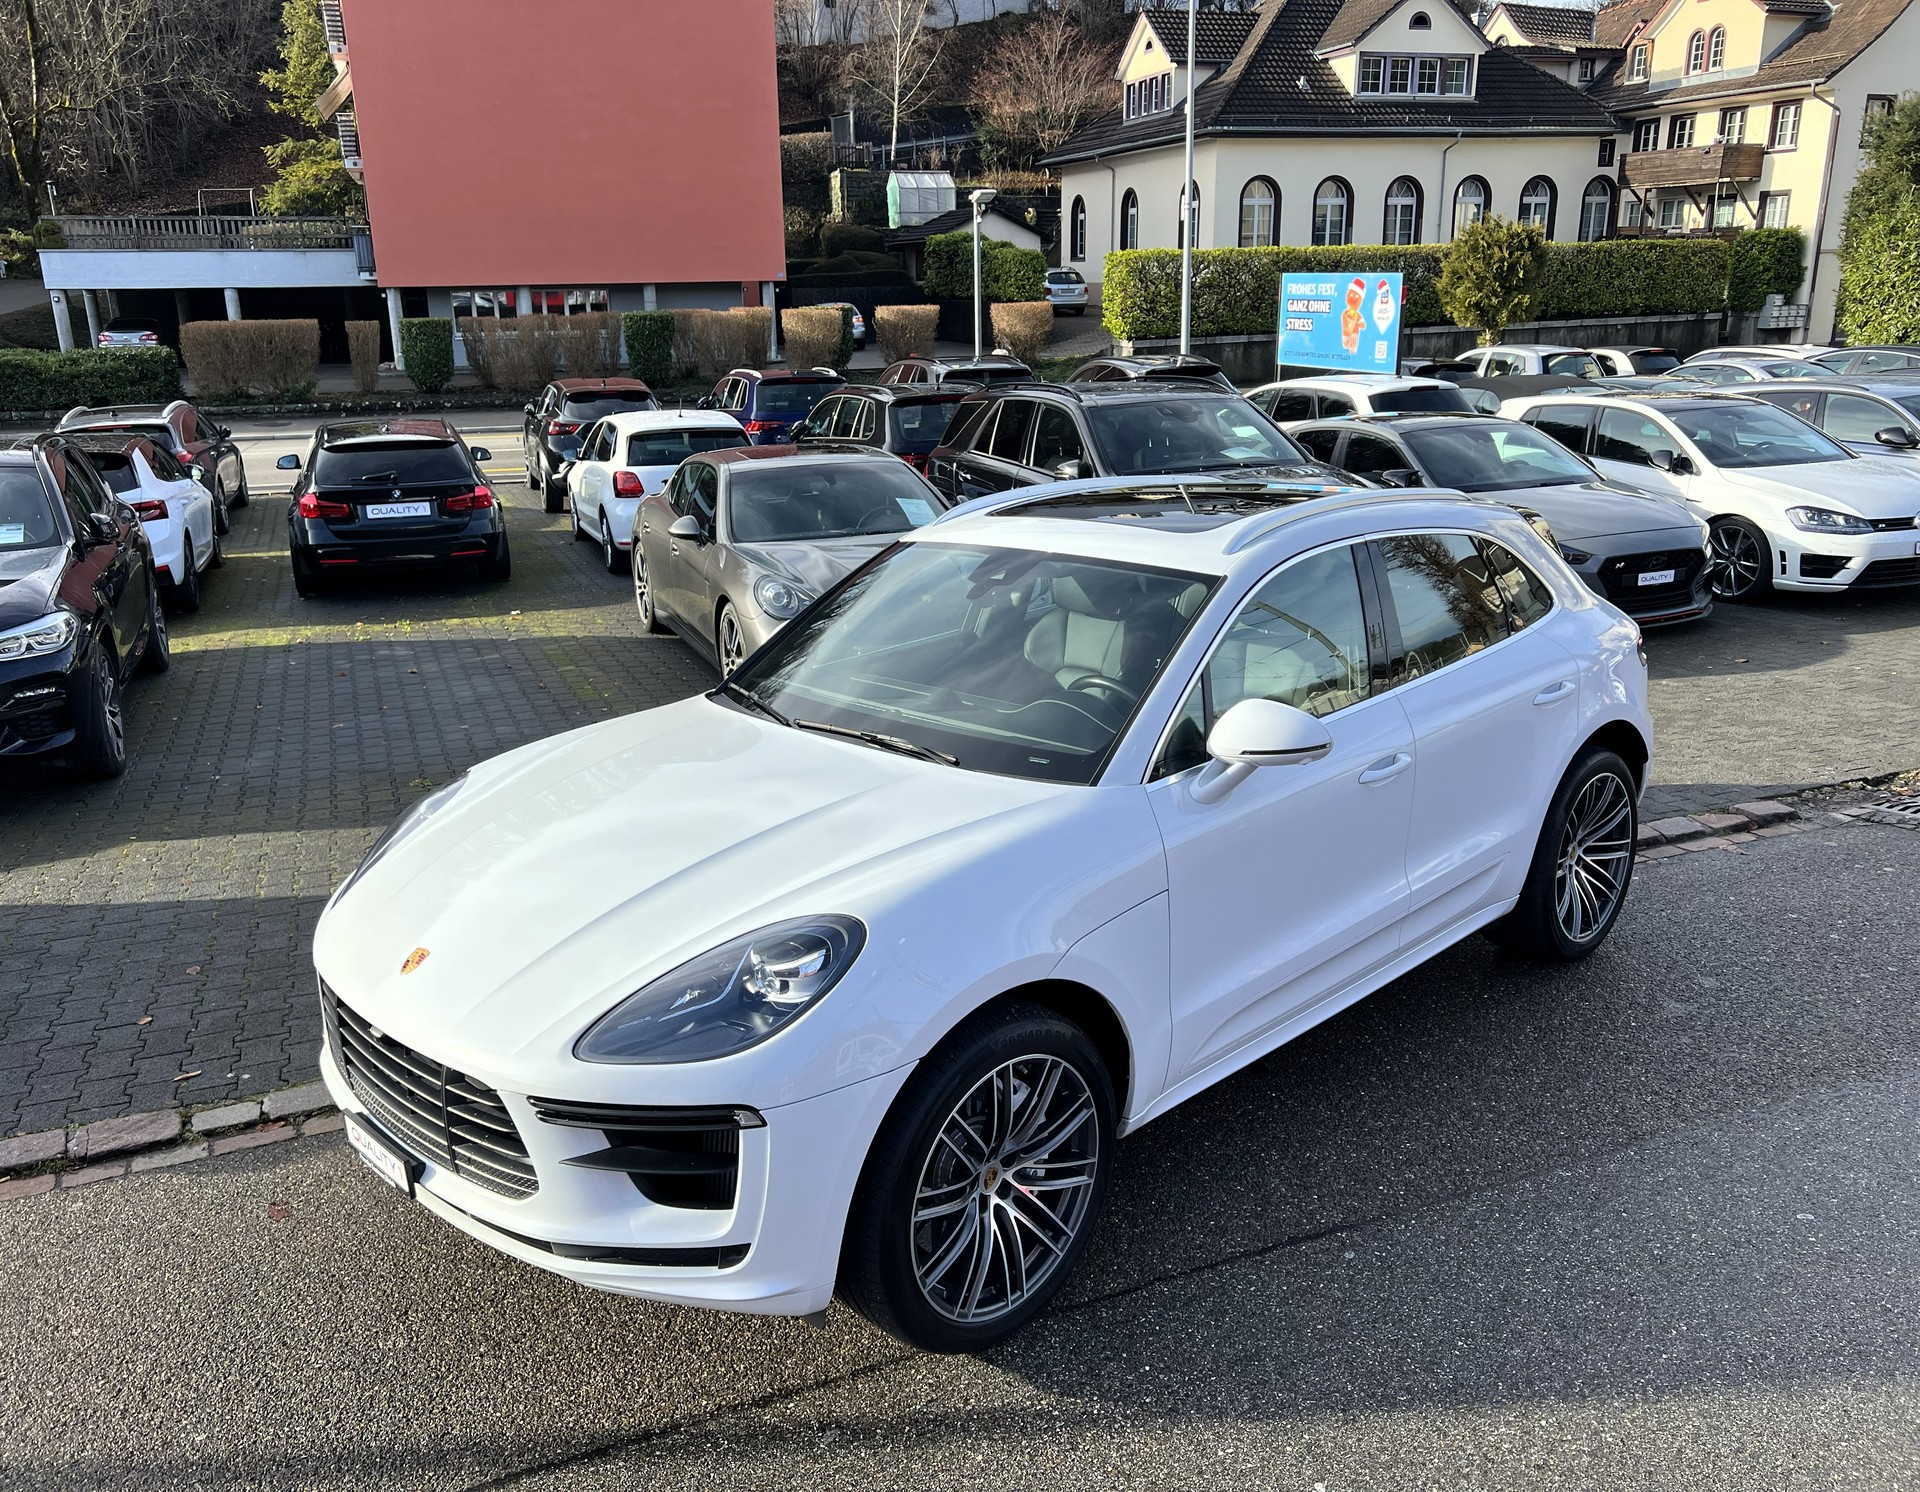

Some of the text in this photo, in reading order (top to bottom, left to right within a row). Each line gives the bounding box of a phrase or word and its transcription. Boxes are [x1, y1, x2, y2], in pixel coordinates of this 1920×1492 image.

[1287, 283, 1337, 297] FROHES FEST,
[1287, 300, 1330, 313] GANZ OHNE
[1286, 318, 1312, 330] STRESS
[371, 506, 420, 515] QUALITY
[1640, 574, 1668, 583] QUALITY
[352, 1127, 396, 1173] QUALITY
